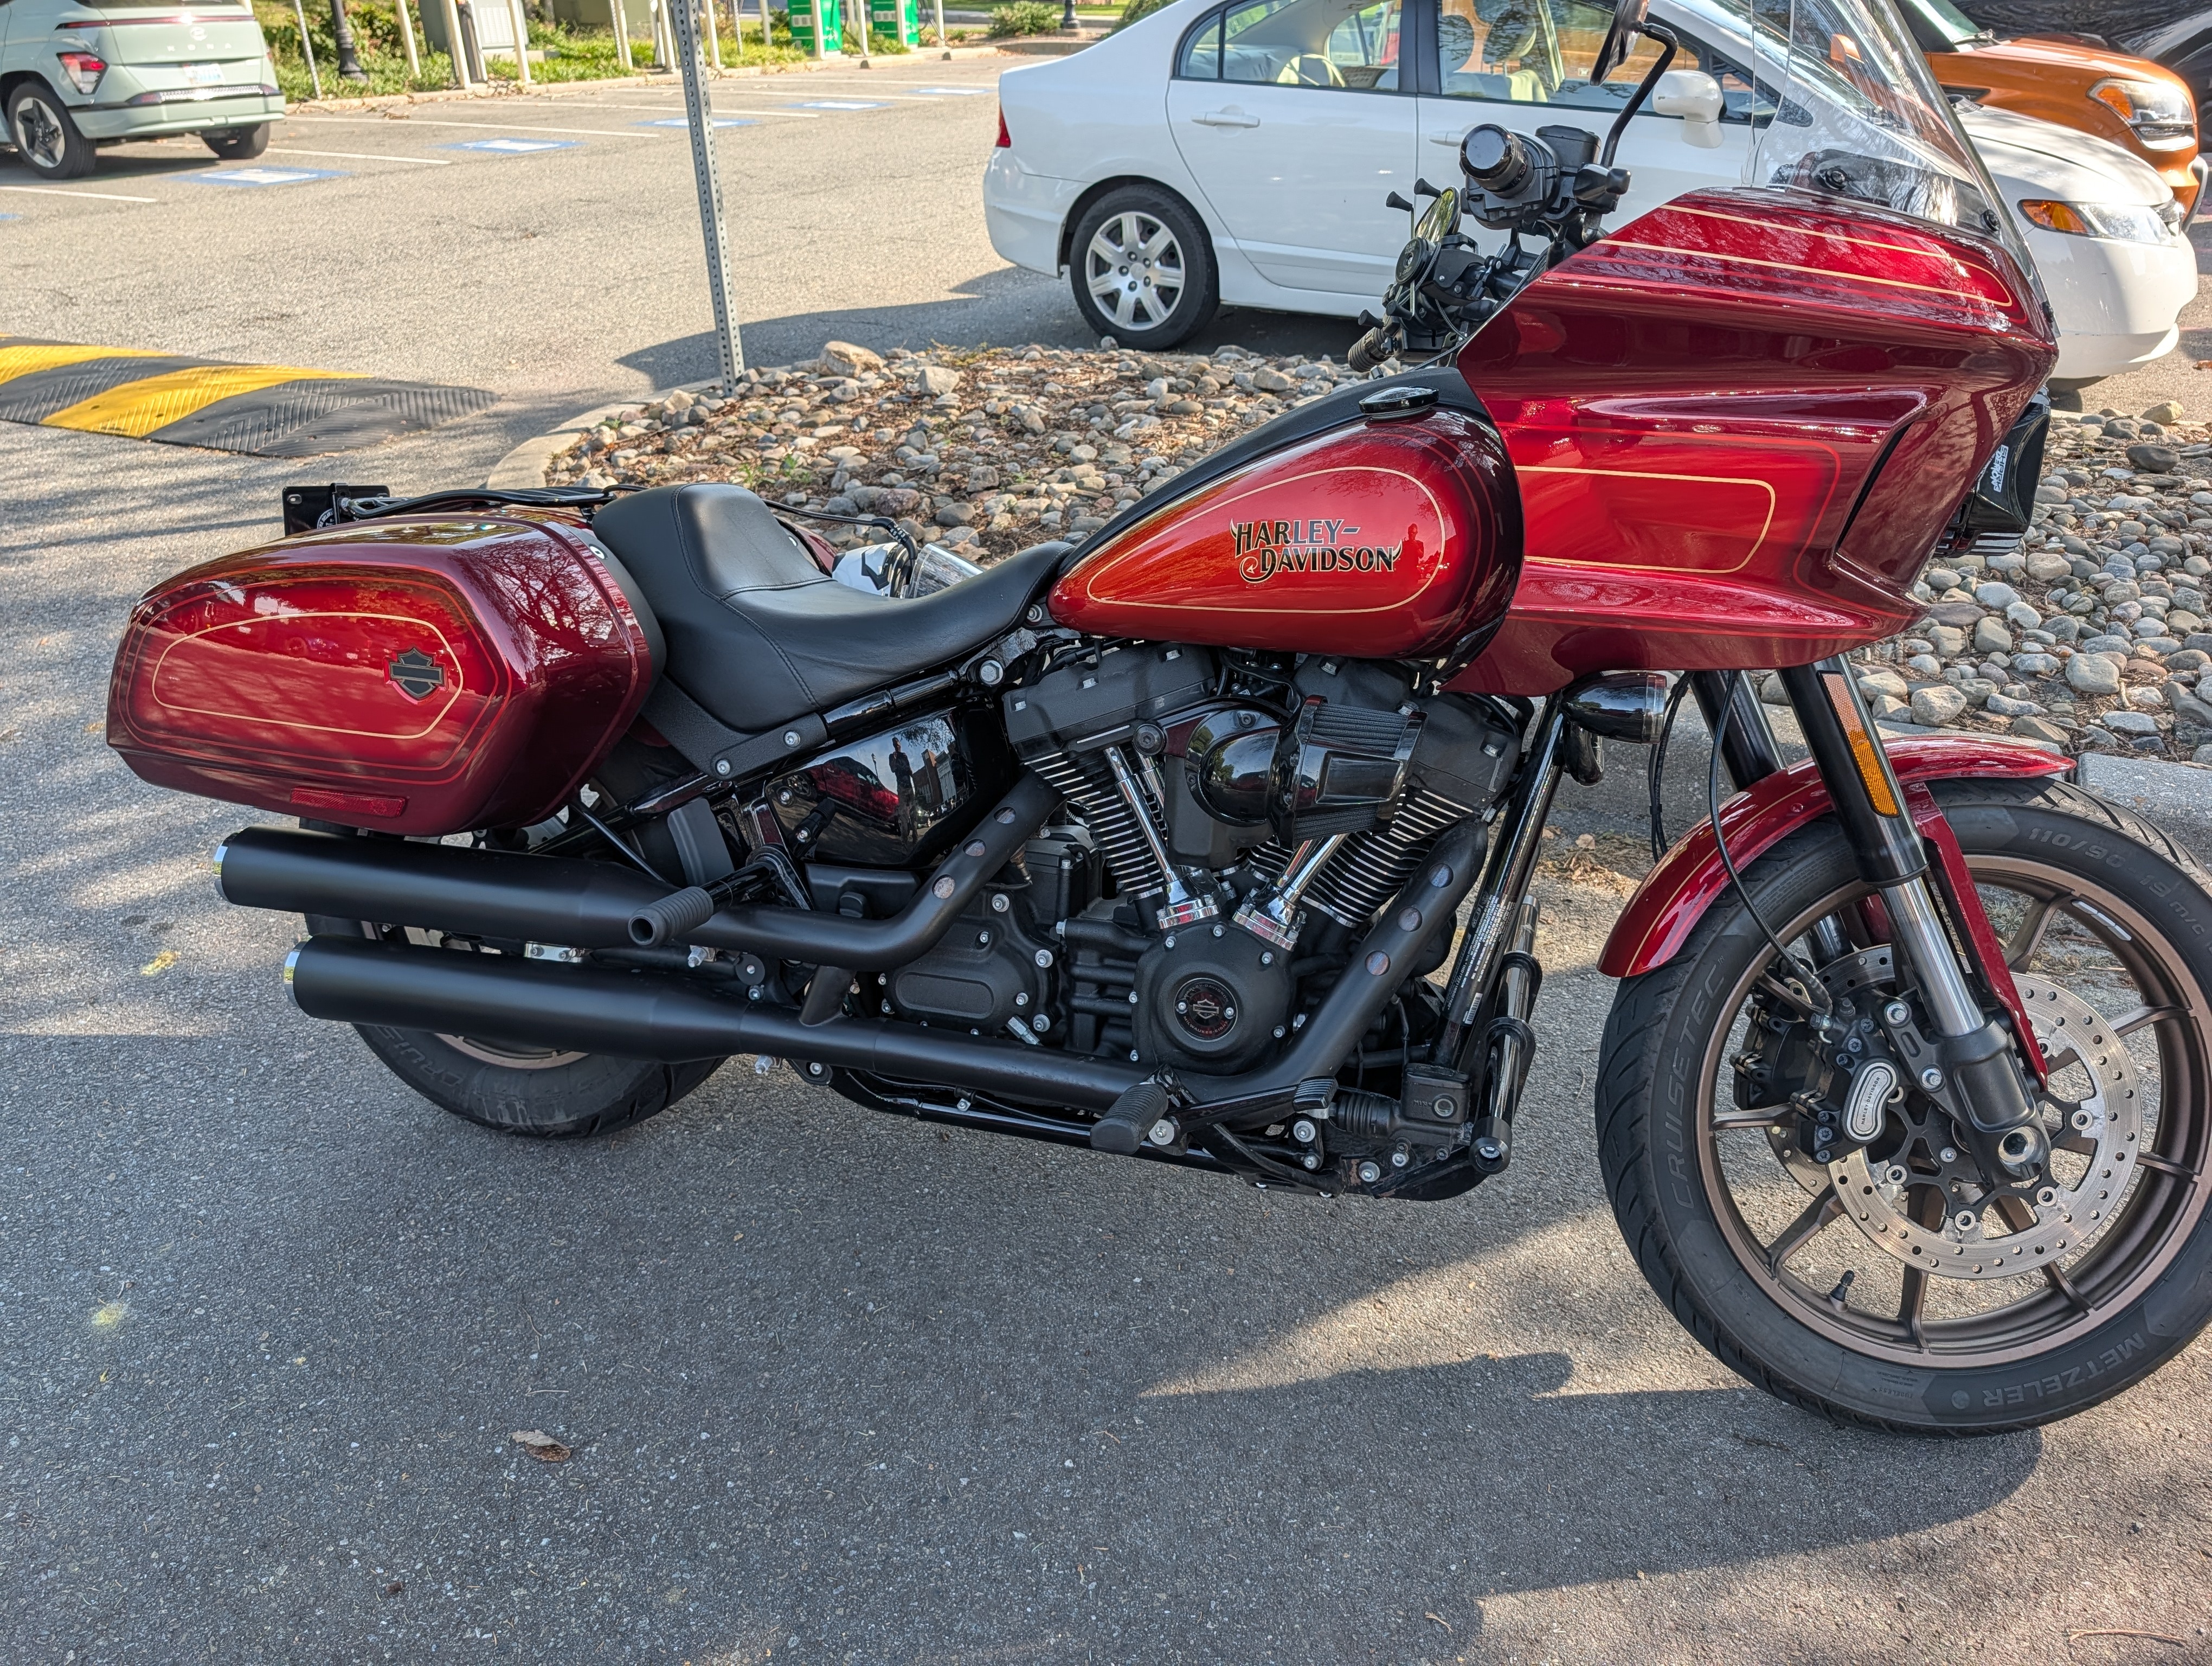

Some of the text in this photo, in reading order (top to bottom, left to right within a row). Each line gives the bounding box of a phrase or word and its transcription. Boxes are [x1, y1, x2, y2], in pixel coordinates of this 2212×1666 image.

[1229, 518, 1361, 558] HARLEY-
[1239, 539, 1403, 583] DAVIDSON
[1861, 1077, 1880, 1125] HARLEY-DAVIDSON
[1982, 1332, 2146, 1407] METZELER
